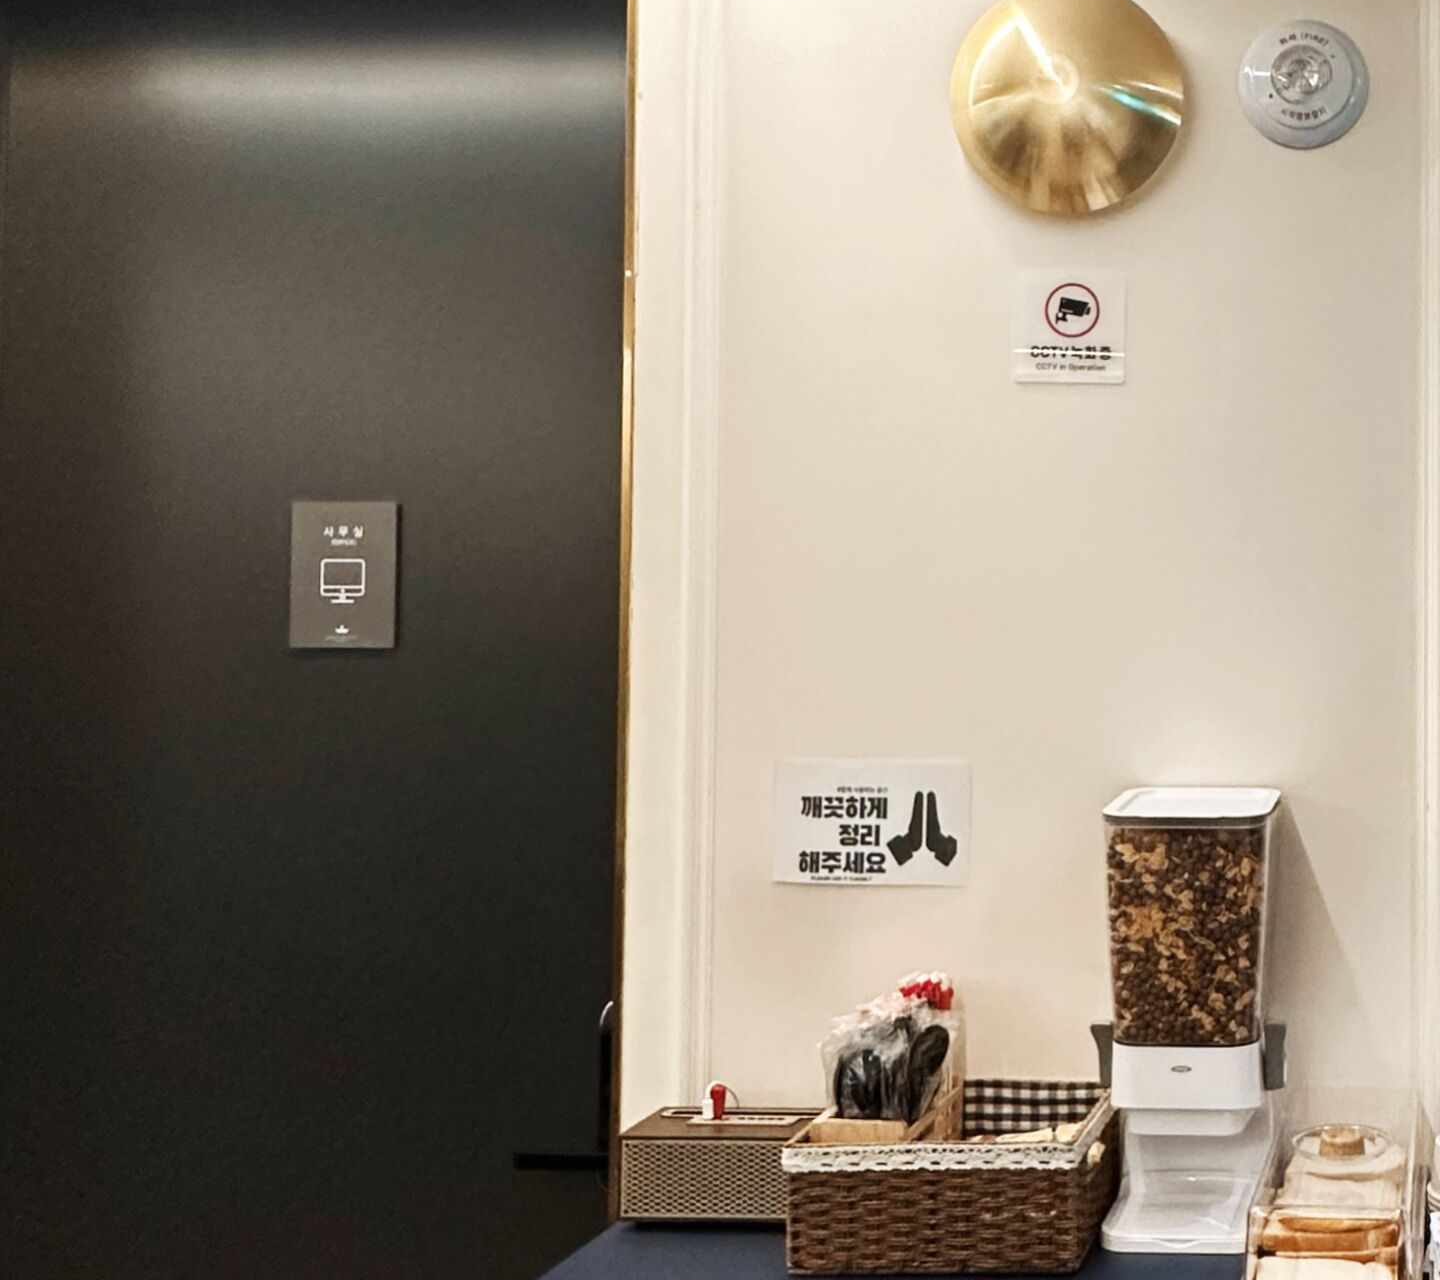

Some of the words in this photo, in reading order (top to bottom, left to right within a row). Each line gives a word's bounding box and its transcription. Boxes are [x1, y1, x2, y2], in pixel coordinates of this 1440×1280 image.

[1035, 362, 1058, 371] CCTV
[1068, 362, 1107, 372] Operation
[800, 795, 888, 820] 깨끗하게
[838, 823, 881, 847] 정리
[798, 850, 887, 874] 해주세요
